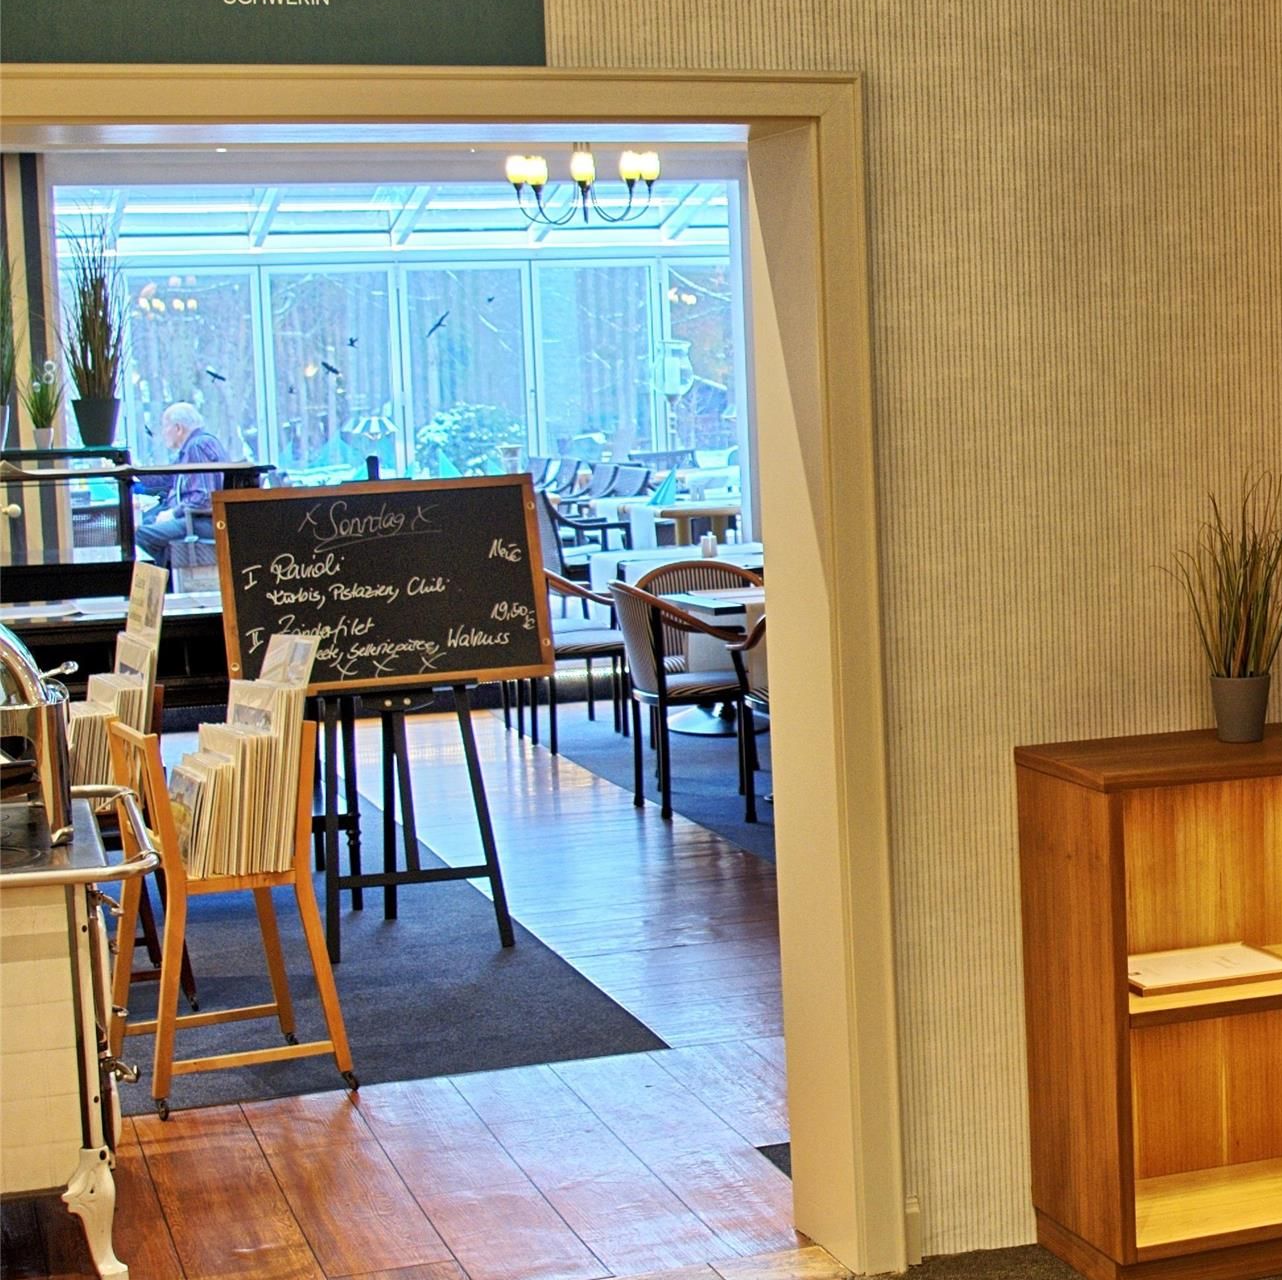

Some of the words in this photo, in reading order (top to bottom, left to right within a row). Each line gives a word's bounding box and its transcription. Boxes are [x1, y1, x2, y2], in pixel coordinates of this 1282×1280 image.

[313, 500, 405, 541] Sonntag
[270, 553, 345, 584] Ravioli
[328, 582, 399, 603] Pistazien,
[407, 576, 450, 596] Chili
[447, 623, 510, 648] Walnuss
